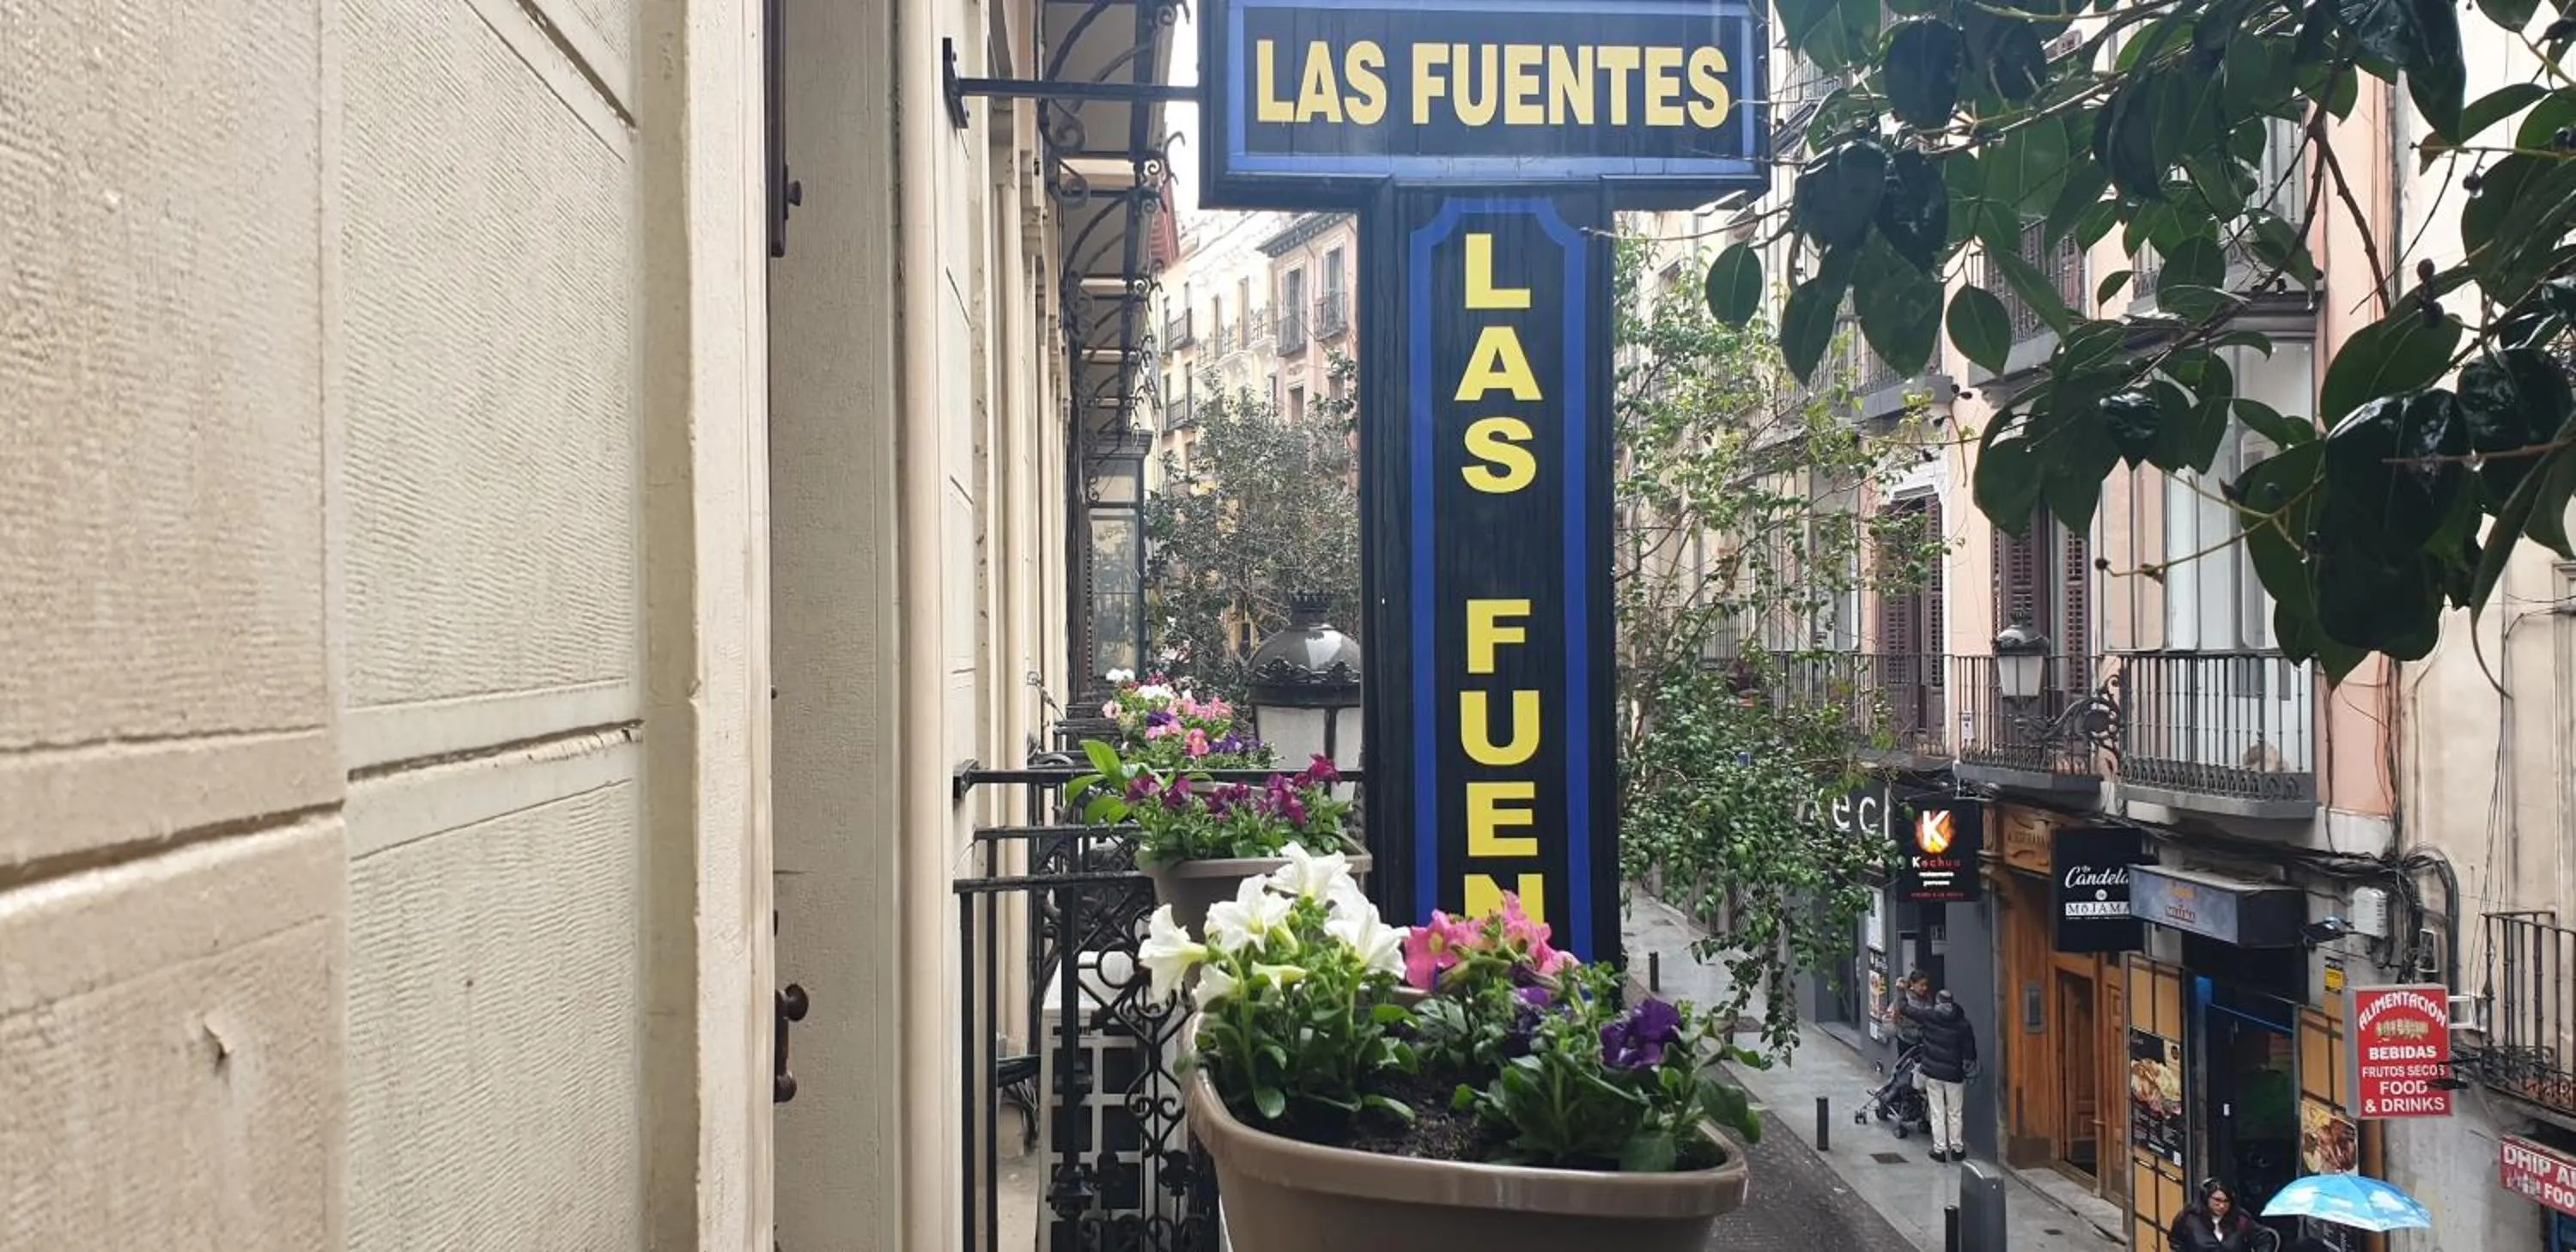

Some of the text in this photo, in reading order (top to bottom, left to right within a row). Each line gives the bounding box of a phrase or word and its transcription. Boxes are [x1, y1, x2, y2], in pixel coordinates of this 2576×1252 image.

[1255, 40, 1730, 129] LAS FUENTES
[1454, 233, 1544, 494] LAS
[1923, 810, 1950, 851] K
[2358, 991, 2446, 1030] ALIMENTACIÓN
[2368, 1045, 2437, 1061] BEBIDAS
[2362, 1066, 2405, 1078] FRUTOS
[2379, 1079, 2428, 1096] FOOD
[2365, 1097, 2445, 1114] & DRINKS
[2503, 1145, 2551, 1176] DHIP
